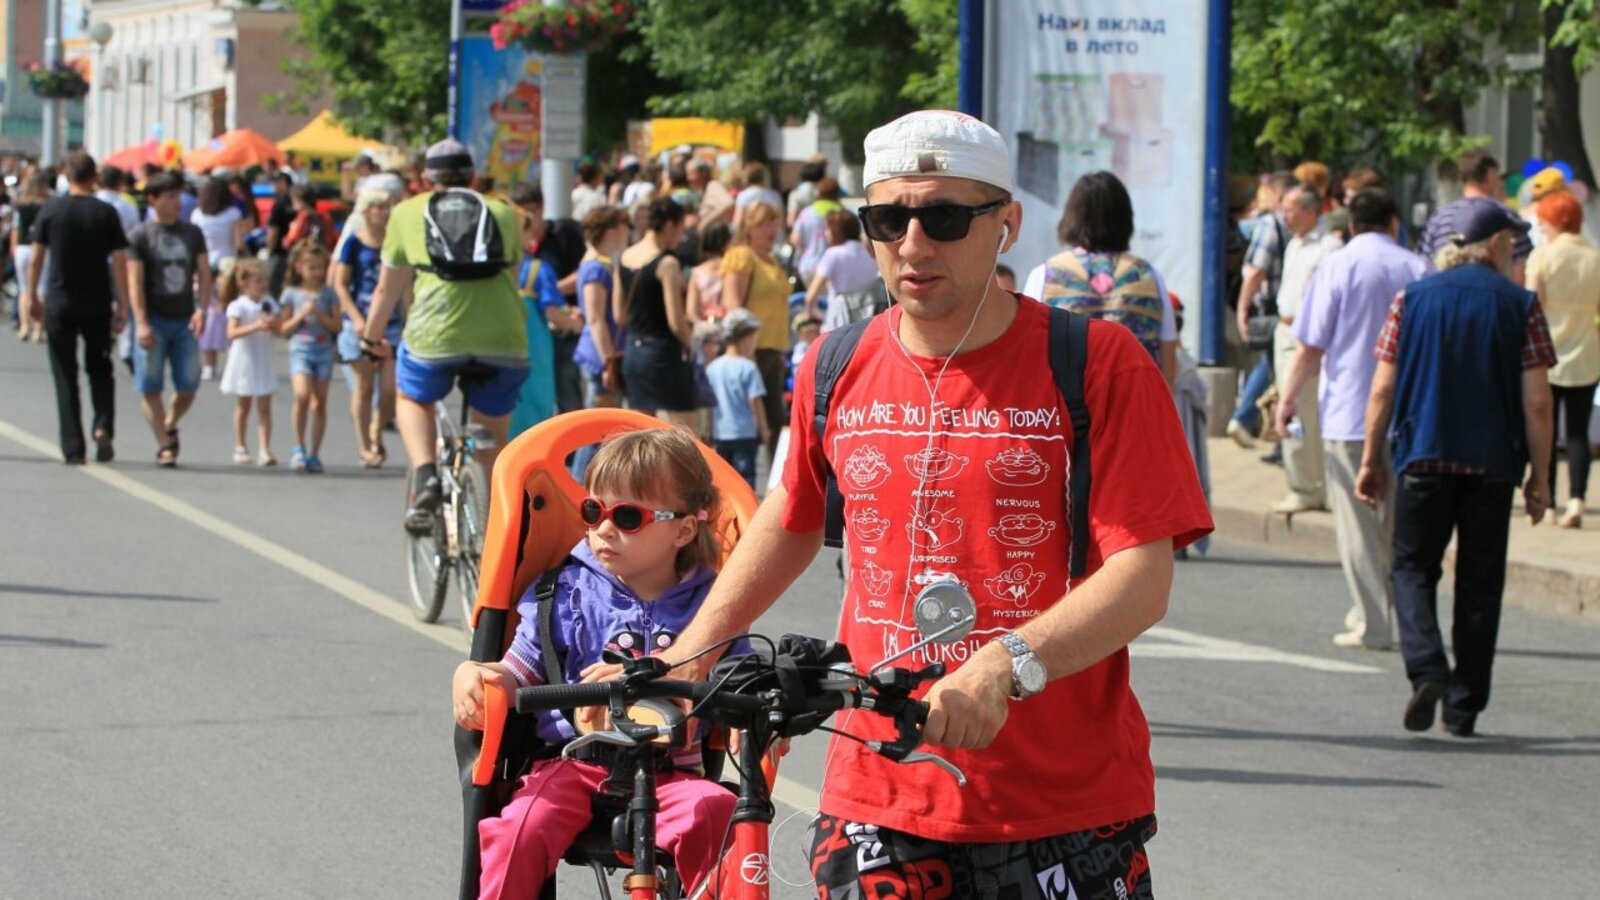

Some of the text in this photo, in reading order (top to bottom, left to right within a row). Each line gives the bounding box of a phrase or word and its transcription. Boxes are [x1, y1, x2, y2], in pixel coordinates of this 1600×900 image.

[1098, 18, 1165, 34] вклад
[1065, 40, 1138, 55] в лето
[837, 404, 867, 430] HOW
[867, 400, 898, 424] ARE
[899, 401, 926, 426] YOU
[930, 400, 1000, 428] FEELING
[995, 498, 1041, 508] NERVOUS
[910, 554, 958, 564] SURPRISED
[1006, 551, 1036, 559] HAPPY
